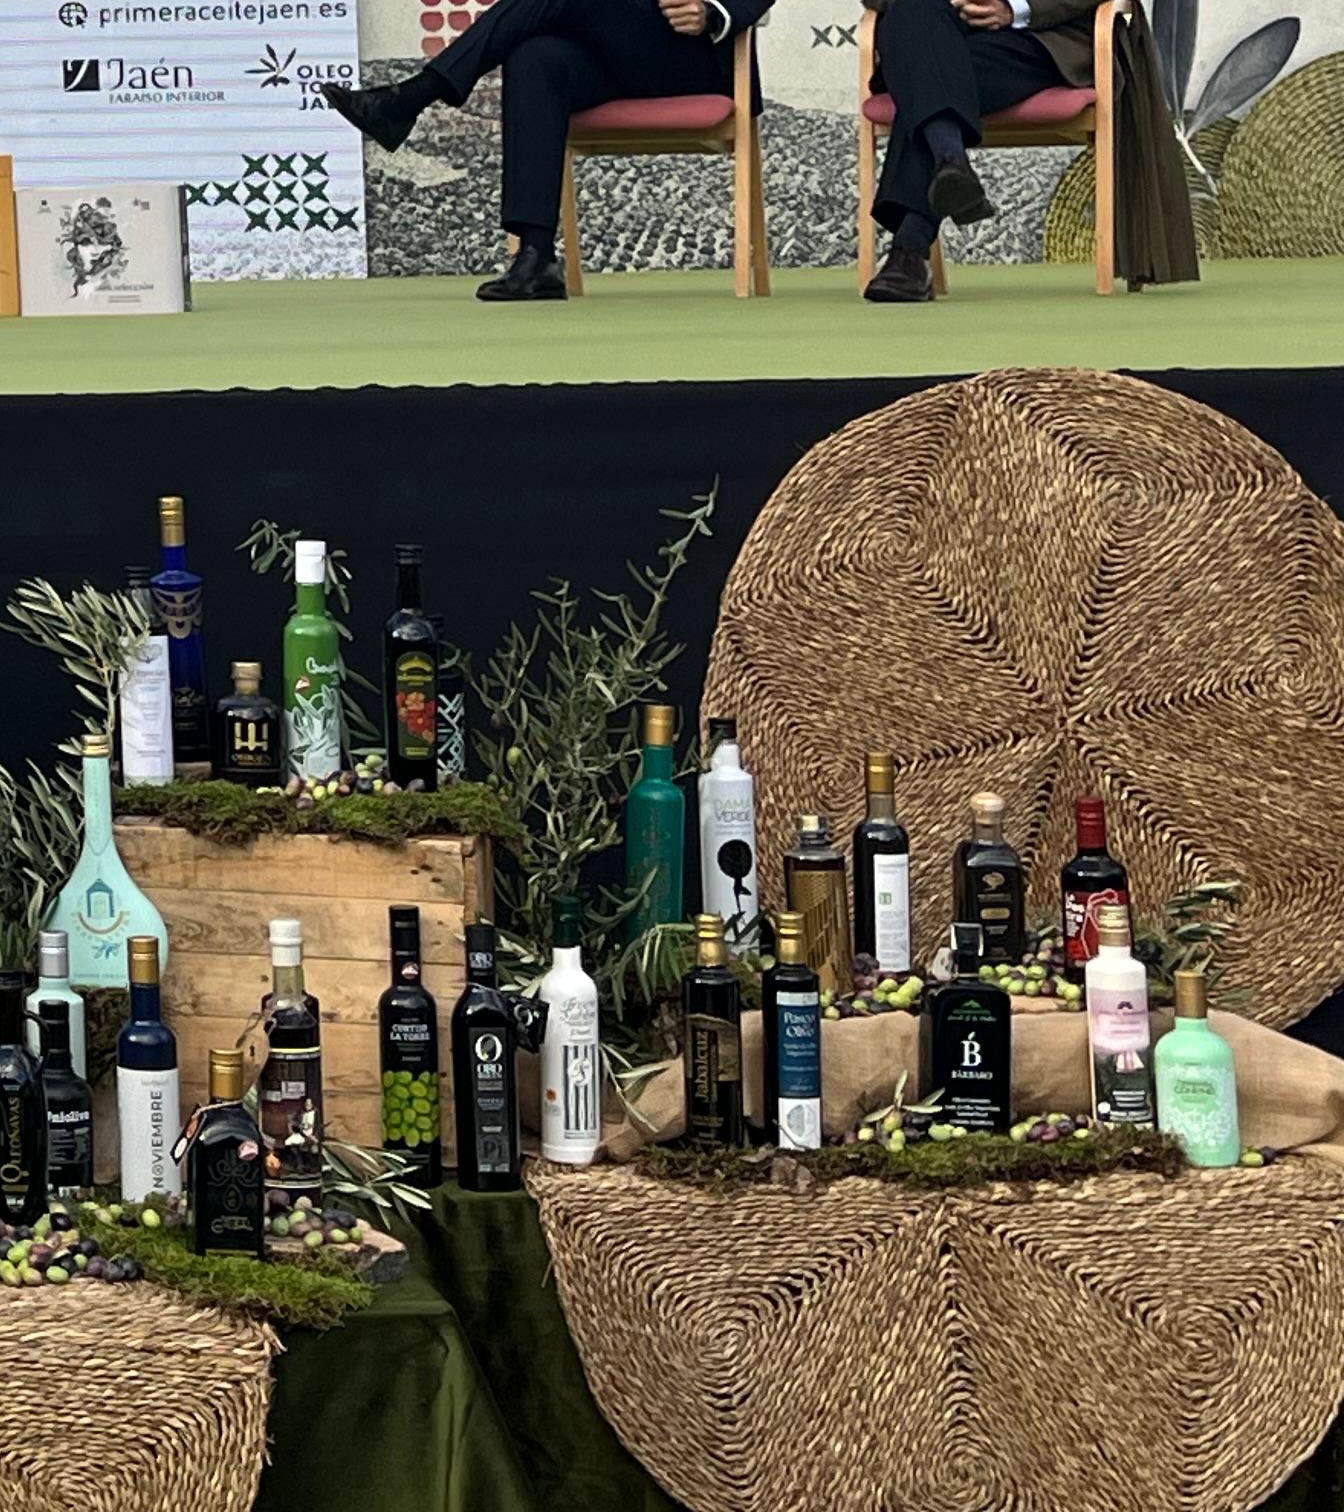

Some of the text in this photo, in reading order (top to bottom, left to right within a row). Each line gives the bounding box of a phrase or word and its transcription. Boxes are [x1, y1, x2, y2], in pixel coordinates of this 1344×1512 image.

[99, 0, 347, 29] primeraceitejaen.es
[107, 58, 193, 90] Jaén
[297, 63, 353, 79] OLEO
